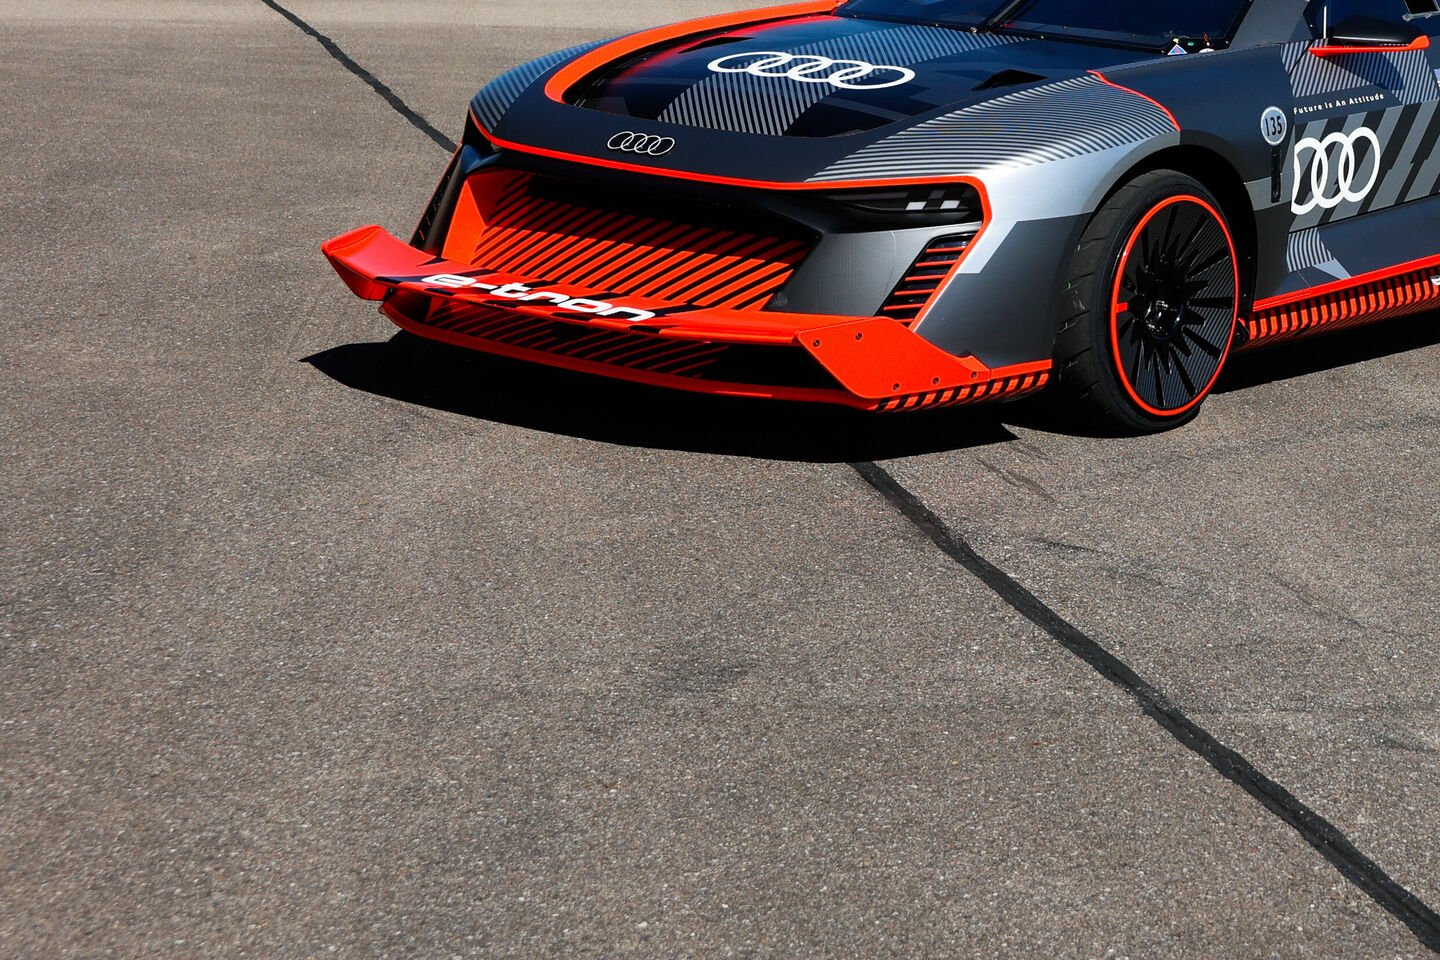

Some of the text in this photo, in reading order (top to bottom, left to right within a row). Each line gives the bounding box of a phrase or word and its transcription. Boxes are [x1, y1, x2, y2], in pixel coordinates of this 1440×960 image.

[1293, 104, 1322, 115] Future
[1335, 99, 1347, 108] An
[1349, 93, 1385, 106] Attitude
[1265, 115, 1283, 137] 135
[421, 273, 656, 322] e-tron
